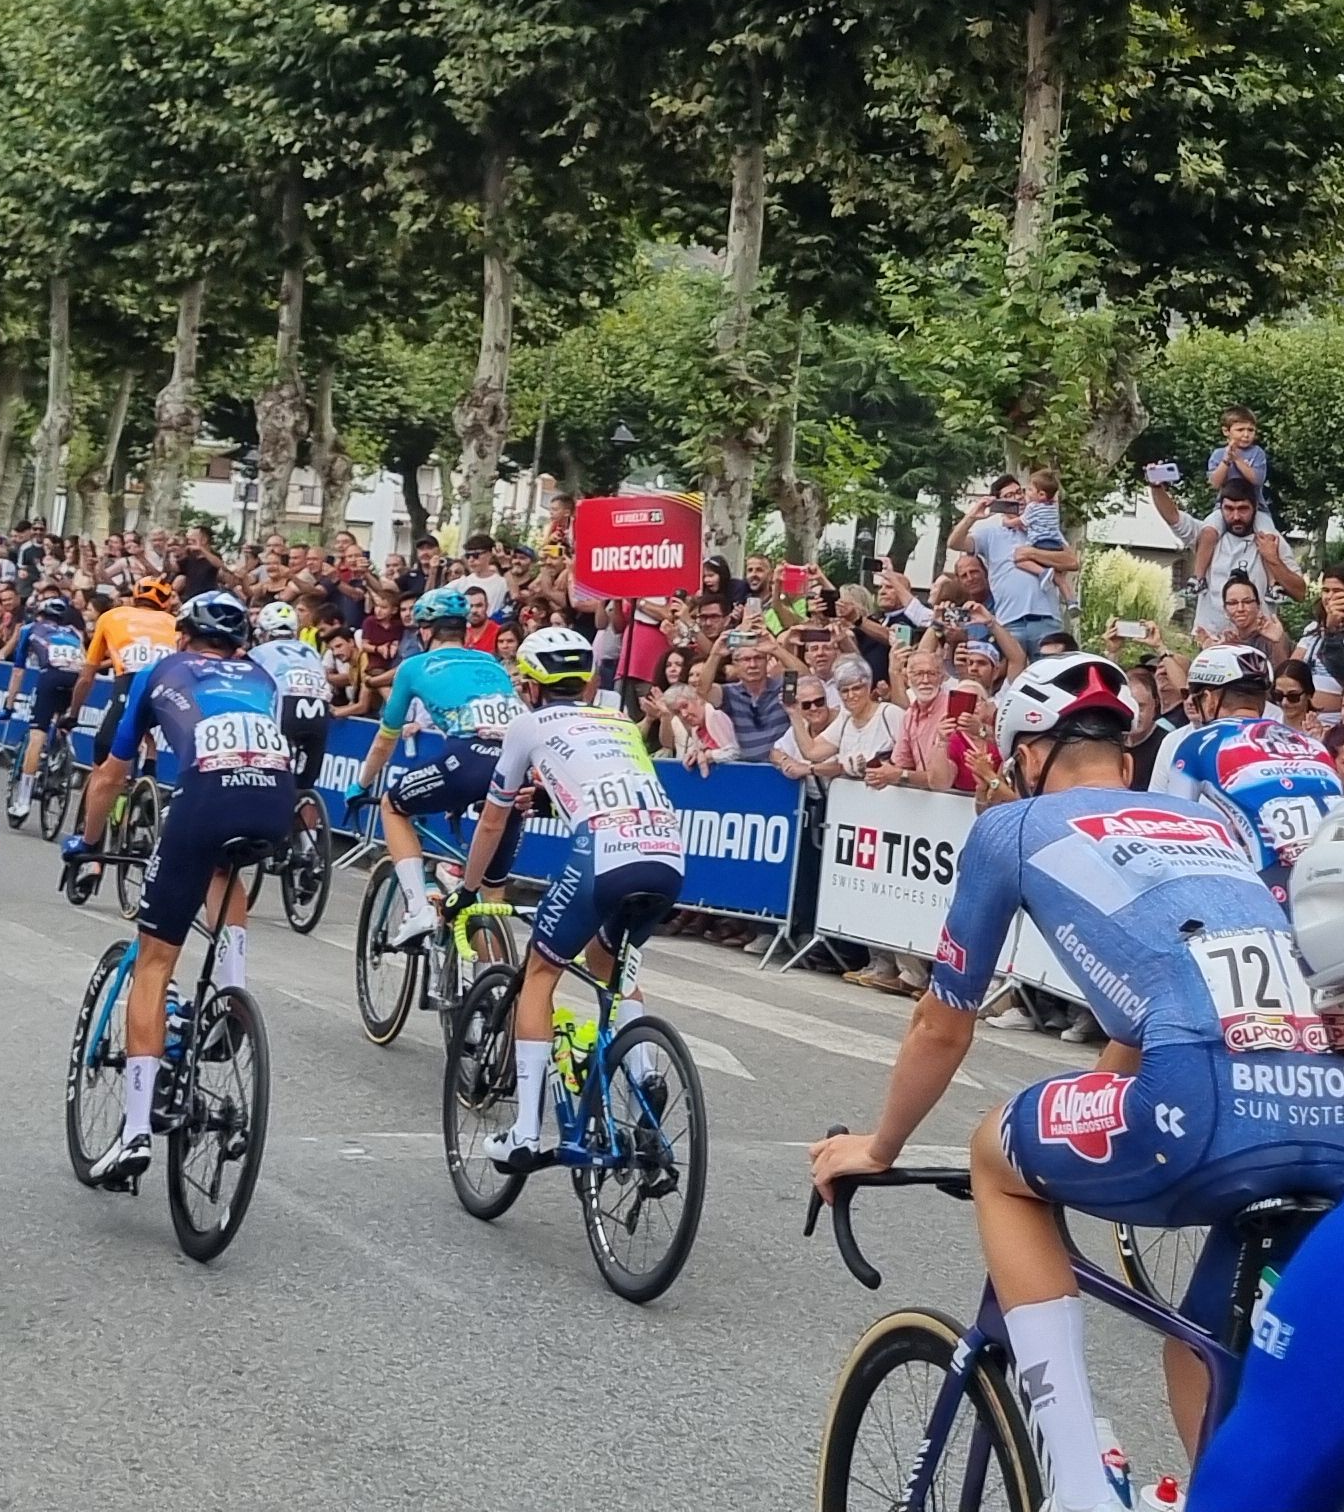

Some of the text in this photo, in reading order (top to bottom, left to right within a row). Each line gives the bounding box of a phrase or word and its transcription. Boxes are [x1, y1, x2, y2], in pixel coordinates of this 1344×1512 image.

[591, 538, 684, 572] DIRECCIÓN
[52, 649, 68, 659] 84
[472, 701, 510, 725] 198
[205, 721, 283, 752] 83 83
[545, 735, 576, 761] SITRA
[221, 773, 277, 787] FANTINI
[586, 776, 634, 812] 161
[619, 826, 671, 839] Circus
[677, 809, 790, 865] IMANO
[1272, 804, 1310, 841] 37
[881, 830, 956, 886] TISS
[538, 864, 583, 938] FANTINI
[832, 873, 865, 893] SWISS
[872, 881, 926, 905] WATCHES
[626, 955, 640, 983] 161
[1206, 945, 1282, 1009] 72
[1050, 1083, 1119, 1134] Alpecin
[1233, 1097, 1280, 1122] SUN
[1050, 1116, 1118, 1136] HAIR BOOSTER
